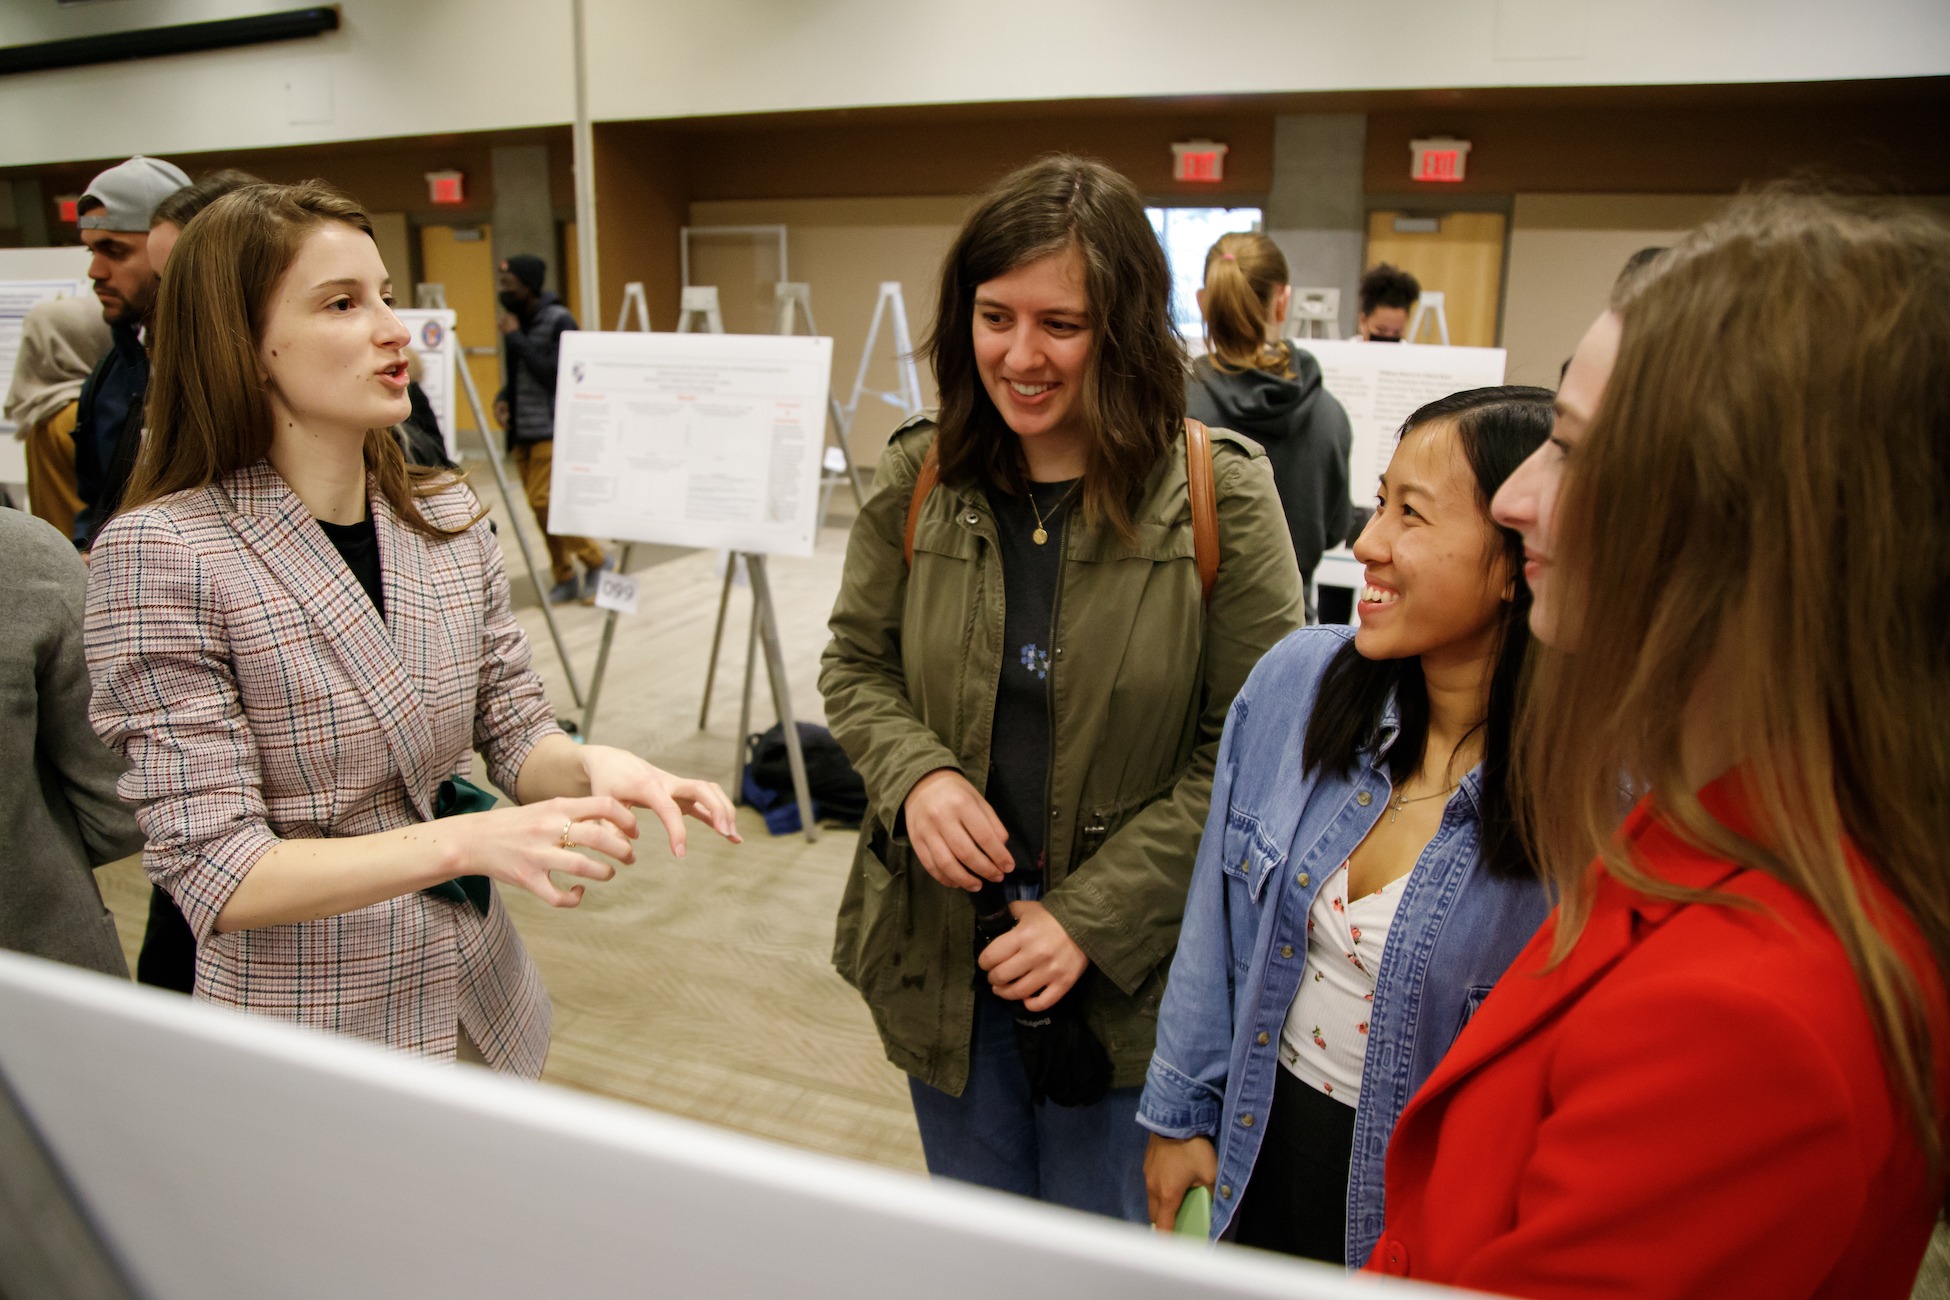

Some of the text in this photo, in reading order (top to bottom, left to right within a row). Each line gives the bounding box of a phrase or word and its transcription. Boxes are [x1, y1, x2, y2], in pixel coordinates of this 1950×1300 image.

[1184, 152, 1216, 179] EXIT
[1422, 150, 1459, 177] EXIT
[603, 580, 635, 602] 099
